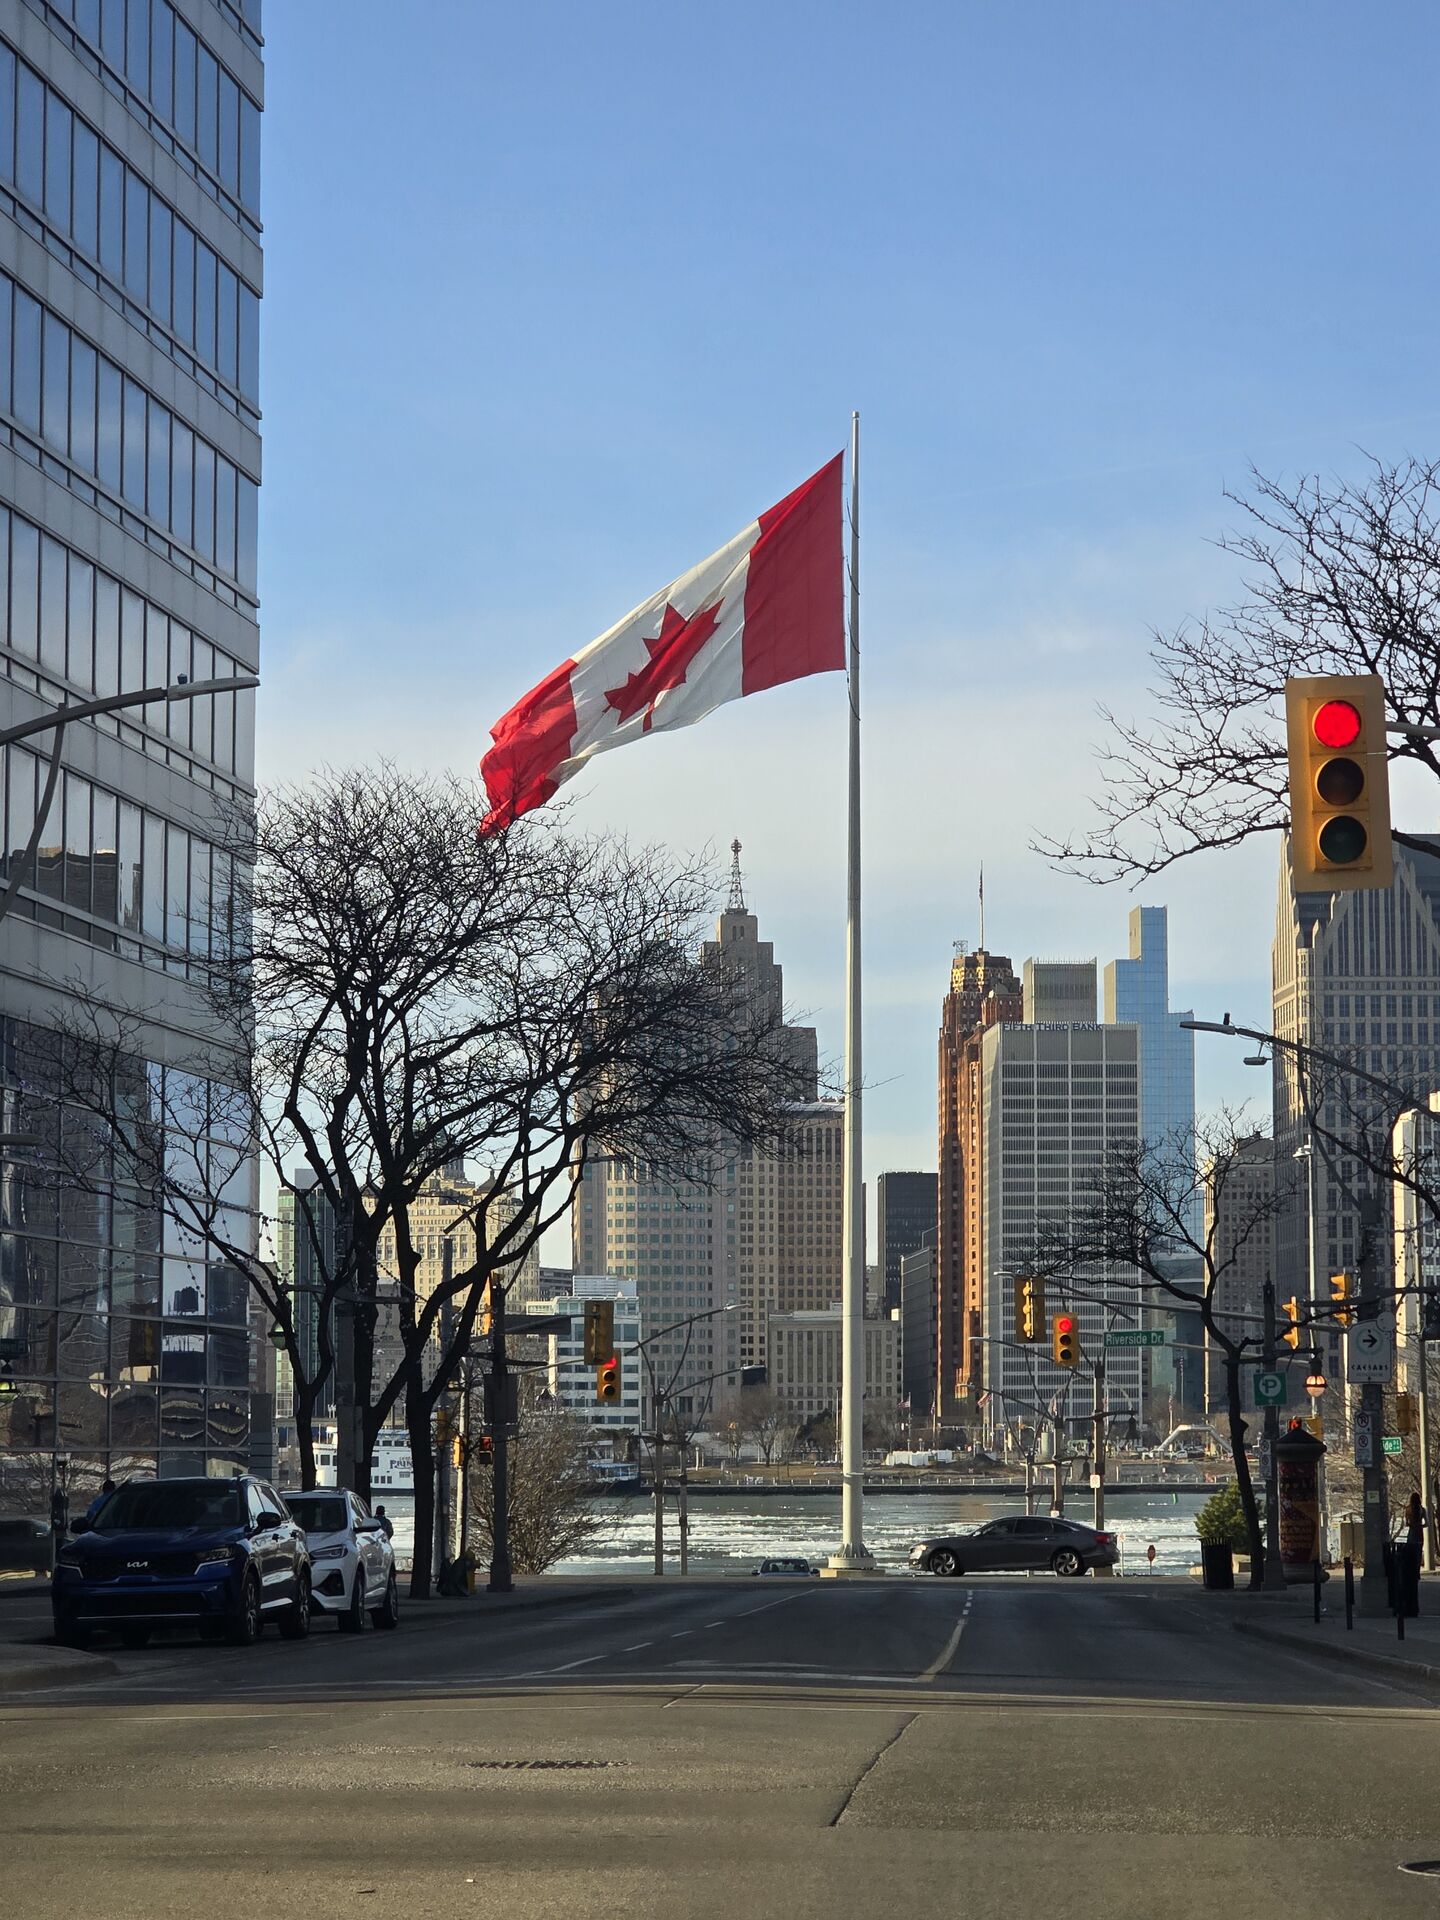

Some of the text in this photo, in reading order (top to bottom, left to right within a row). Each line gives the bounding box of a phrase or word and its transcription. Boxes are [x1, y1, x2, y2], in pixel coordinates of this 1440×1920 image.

[1036, 1022, 1069, 1031] THIRD
[1072, 1022, 1103, 1031] BANK
[1105, 1332, 1163, 1346] Riverside Dr.
[1382, 1440, 1393, 1451] ide
[390, 1459, 413, 1469] PRIN
